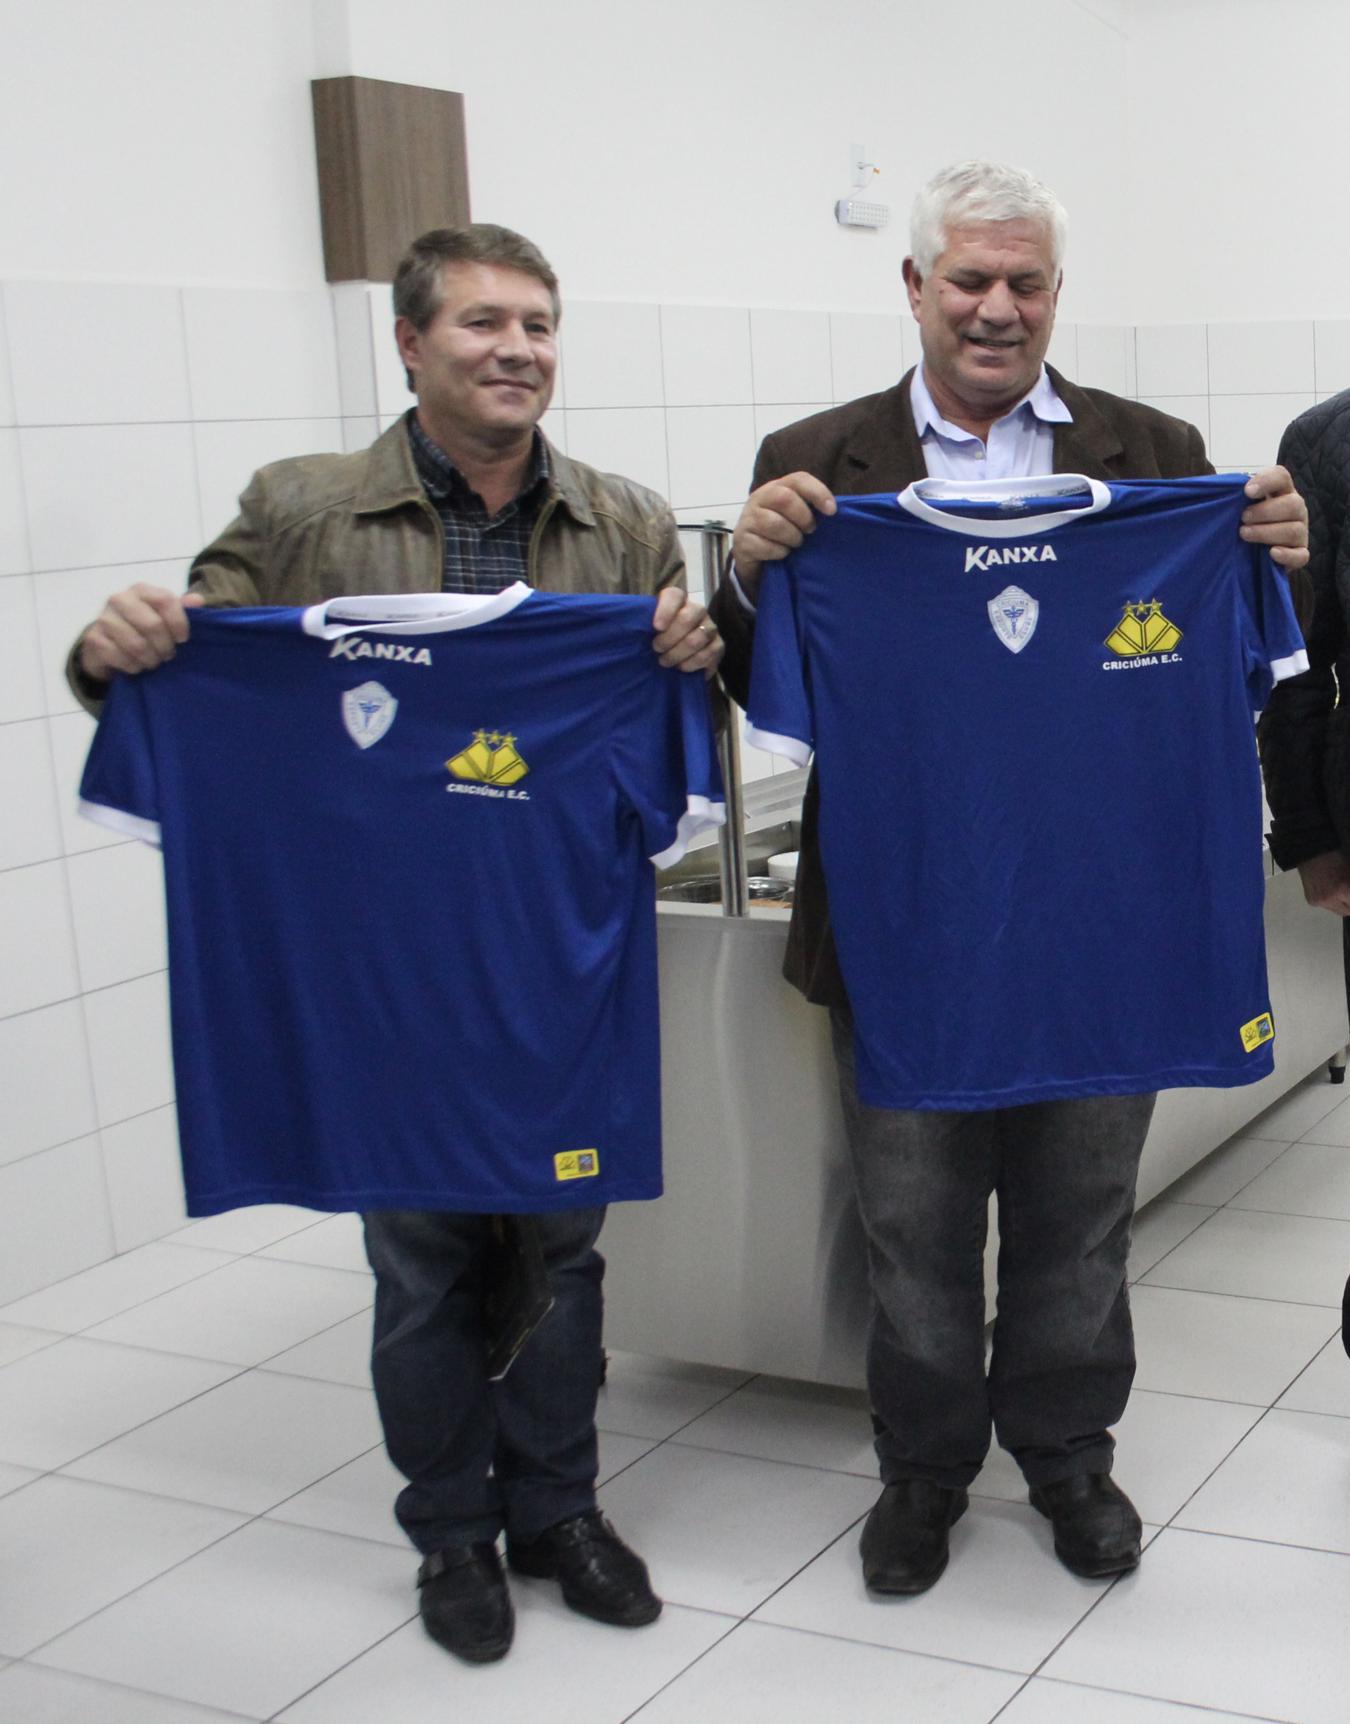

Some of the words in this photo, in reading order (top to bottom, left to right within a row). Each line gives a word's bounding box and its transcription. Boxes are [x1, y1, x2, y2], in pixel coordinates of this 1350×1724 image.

[963, 544, 1058, 573] KANXA
[328, 637, 433, 666] KANXA
[1102, 655, 1159, 671] CRICIÚMA
[1161, 653, 1183, 664] E.C.
